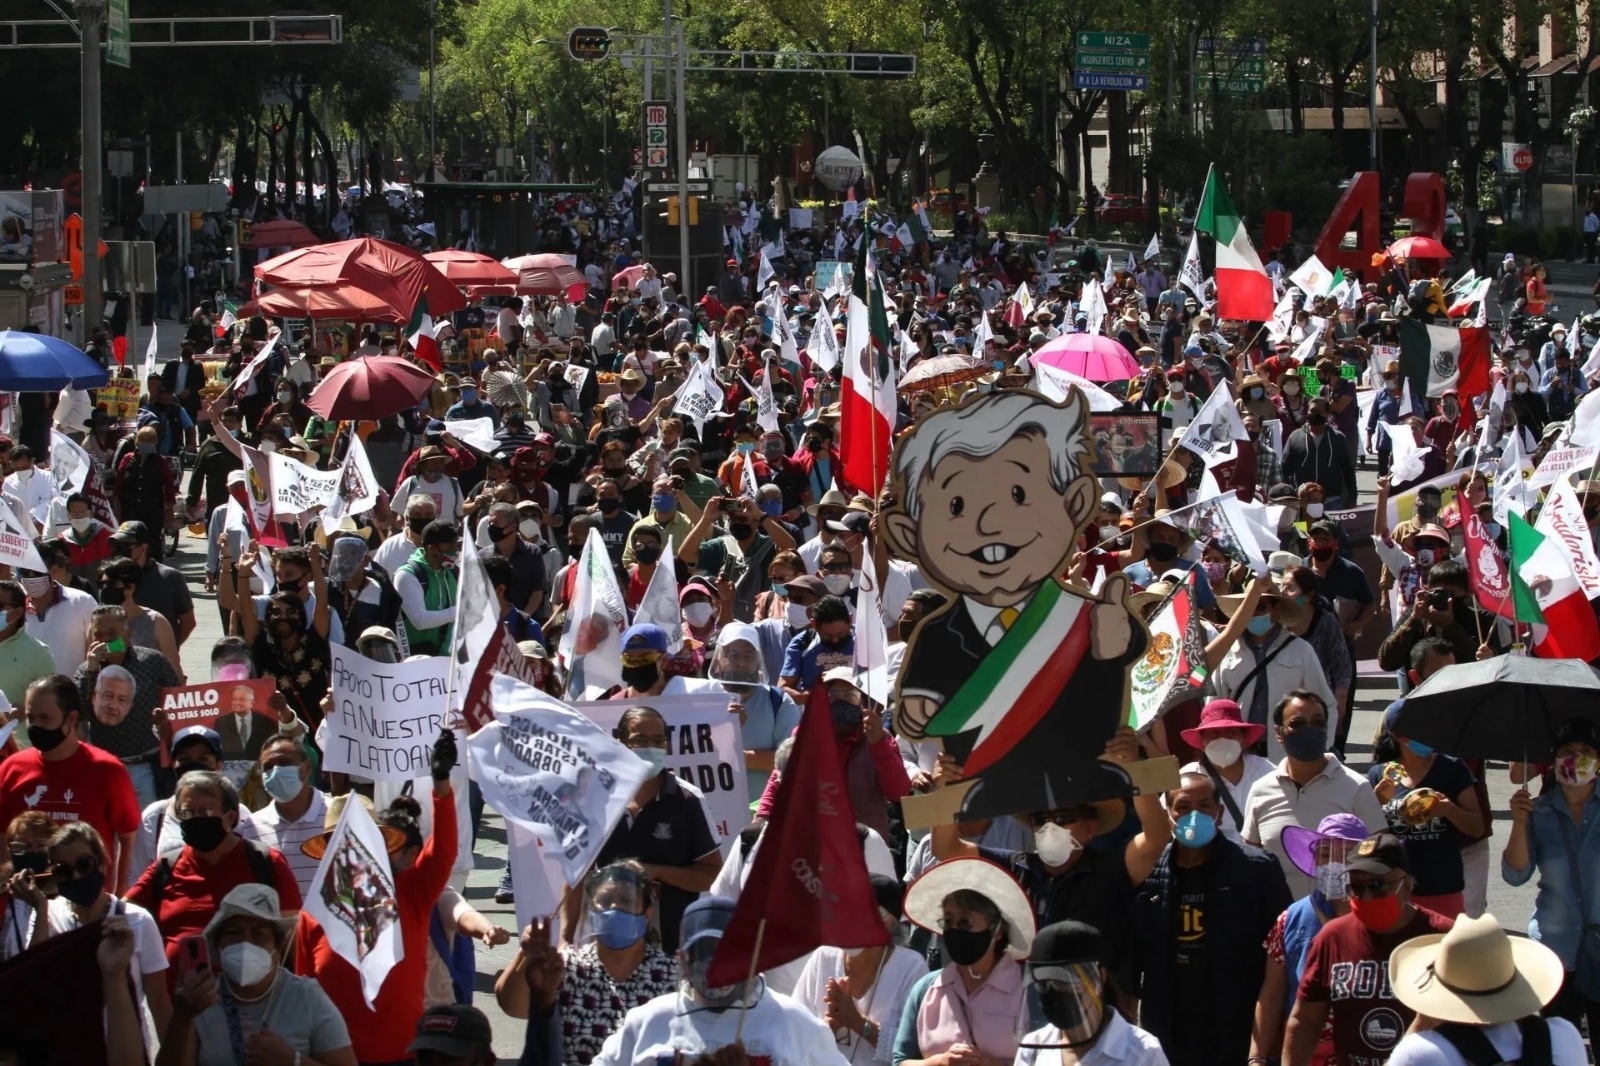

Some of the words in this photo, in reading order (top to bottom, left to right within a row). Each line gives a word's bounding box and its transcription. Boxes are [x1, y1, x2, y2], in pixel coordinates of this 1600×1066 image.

[1104, 35, 1132, 46] NIZA
[1081, 55, 1114, 65] INSURGENTES
[1116, 57, 1134, 66] CENTRO
[1200, 60, 1229, 71] ANNIO
[1091, 76, 1100, 86] LA
[1100, 76, 1132, 87] REVOLUCION
[1219, 81, 1250, 92] RAGUA
[1514, 156, 1532, 164] ALTO
[278, 487, 288, 496] LA
[278, 495, 293, 504] DEL
[0, 532, 29, 550] ESIDENTE
[603, 532, 624, 542] MMY
[333, 656, 373, 699] APOYO
[372, 673, 458, 704] TOTAL
[163, 689, 219, 710] AMLO
[177, 709, 199, 720] ESTAS
[200, 707, 220, 717] SOLO
[342, 699, 357, 730] A
[358, 704, 458, 740] NUESTRO
[666, 723, 715, 756] TAR
[678, 762, 735, 794] ADO
[52, 811, 80, 821] OFFLINE
[1181, 893, 1206, 903] mart
[1181, 903, 1204, 933] it
